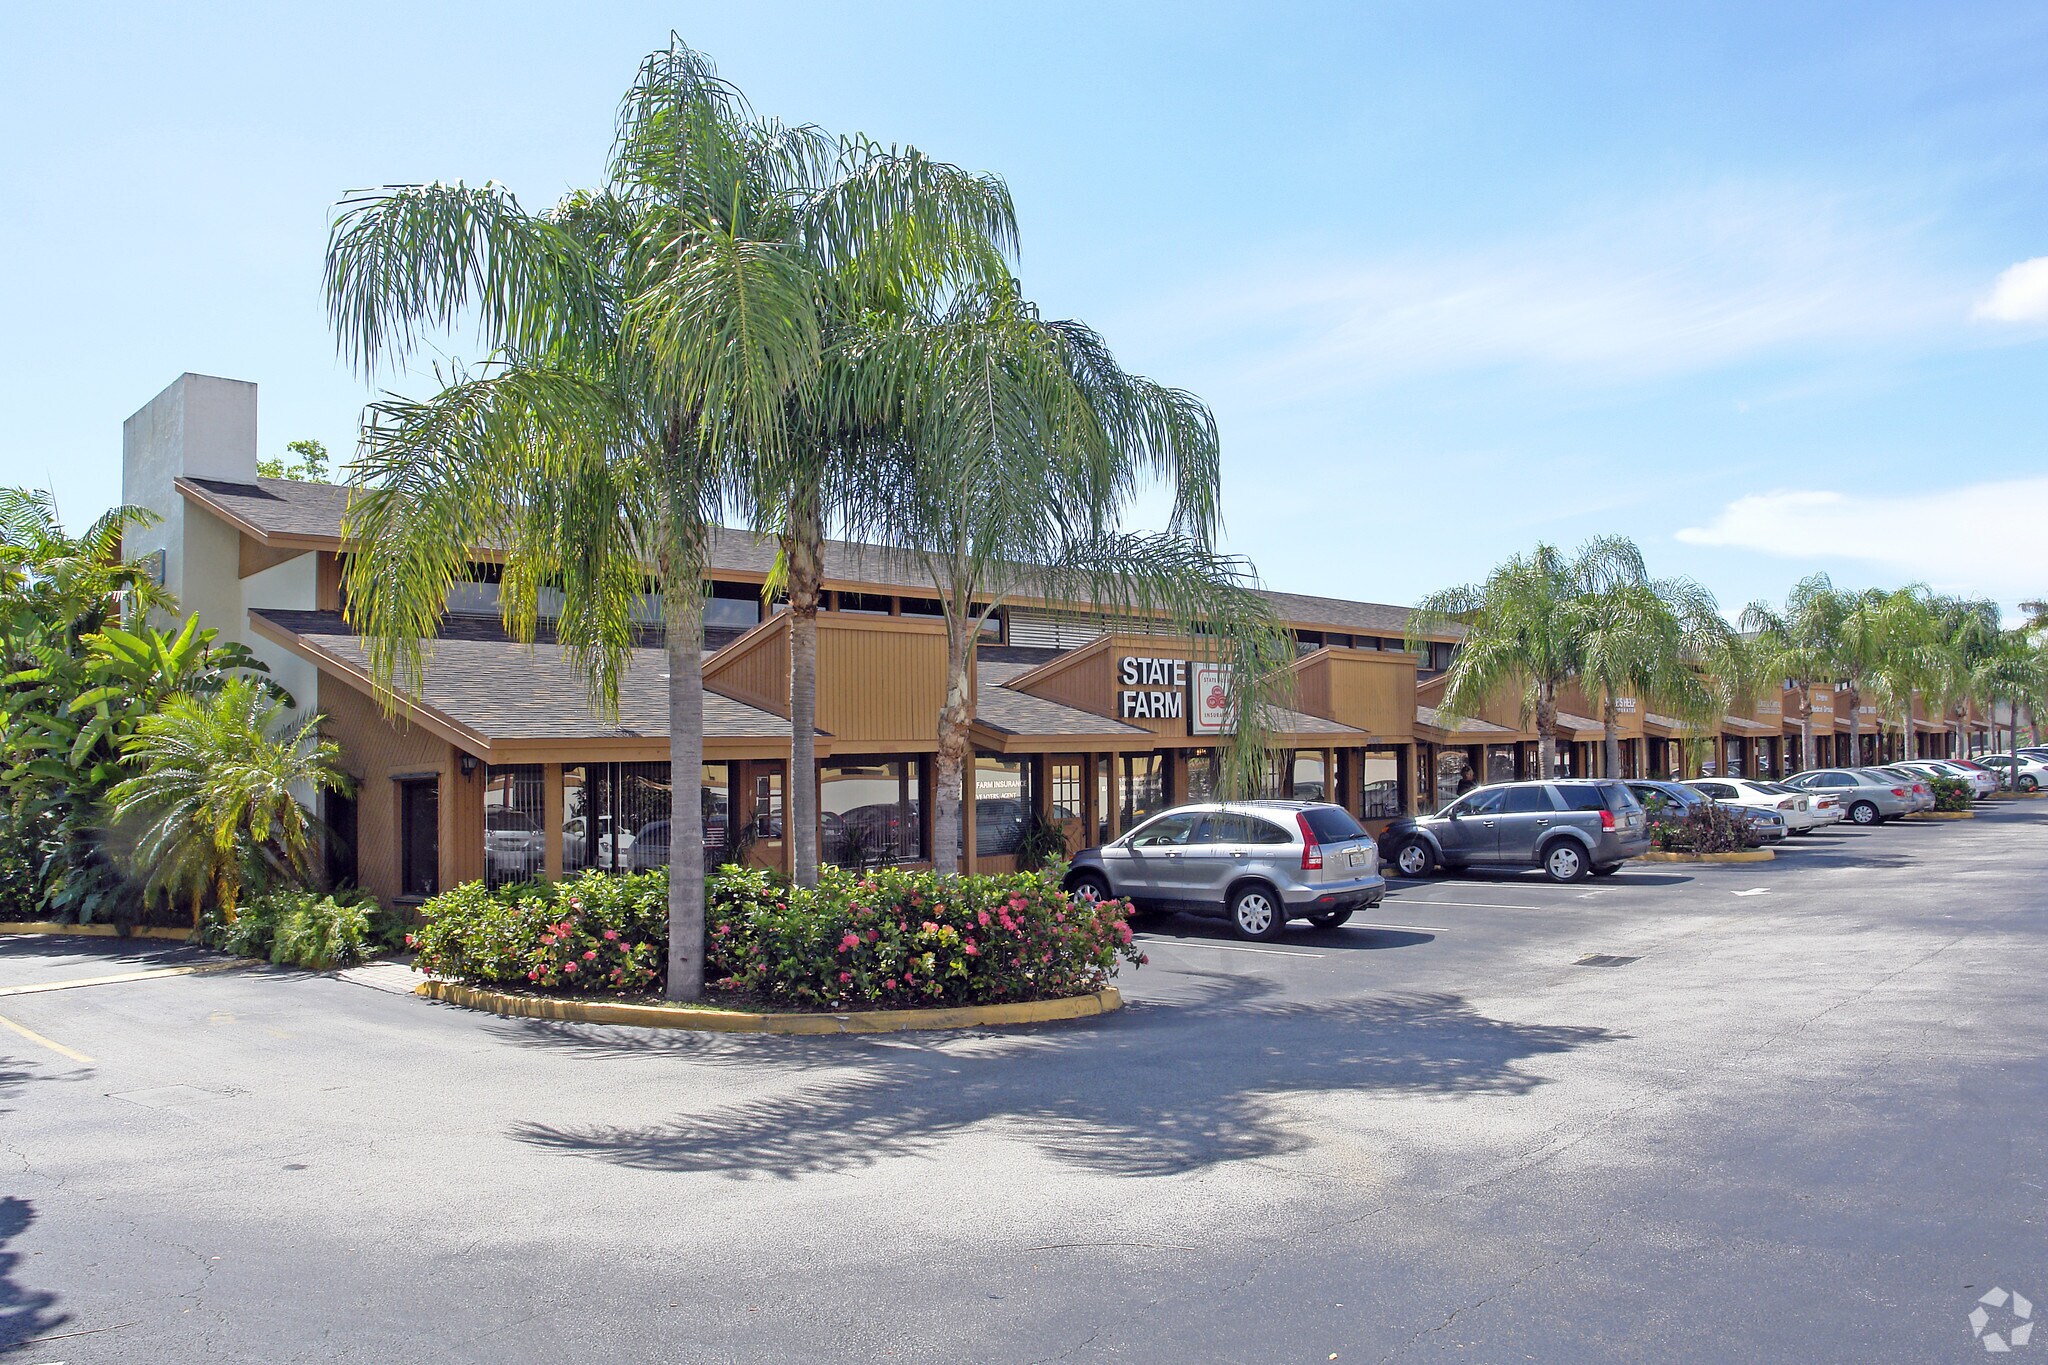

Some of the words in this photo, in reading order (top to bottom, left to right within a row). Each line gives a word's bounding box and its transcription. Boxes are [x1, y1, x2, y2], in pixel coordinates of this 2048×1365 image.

[1122, 657, 1186, 686] STATE
[1123, 691, 1183, 718] FARM
[975, 781, 993, 789] FARM
[993, 779, 1027, 788] INSURANCE
